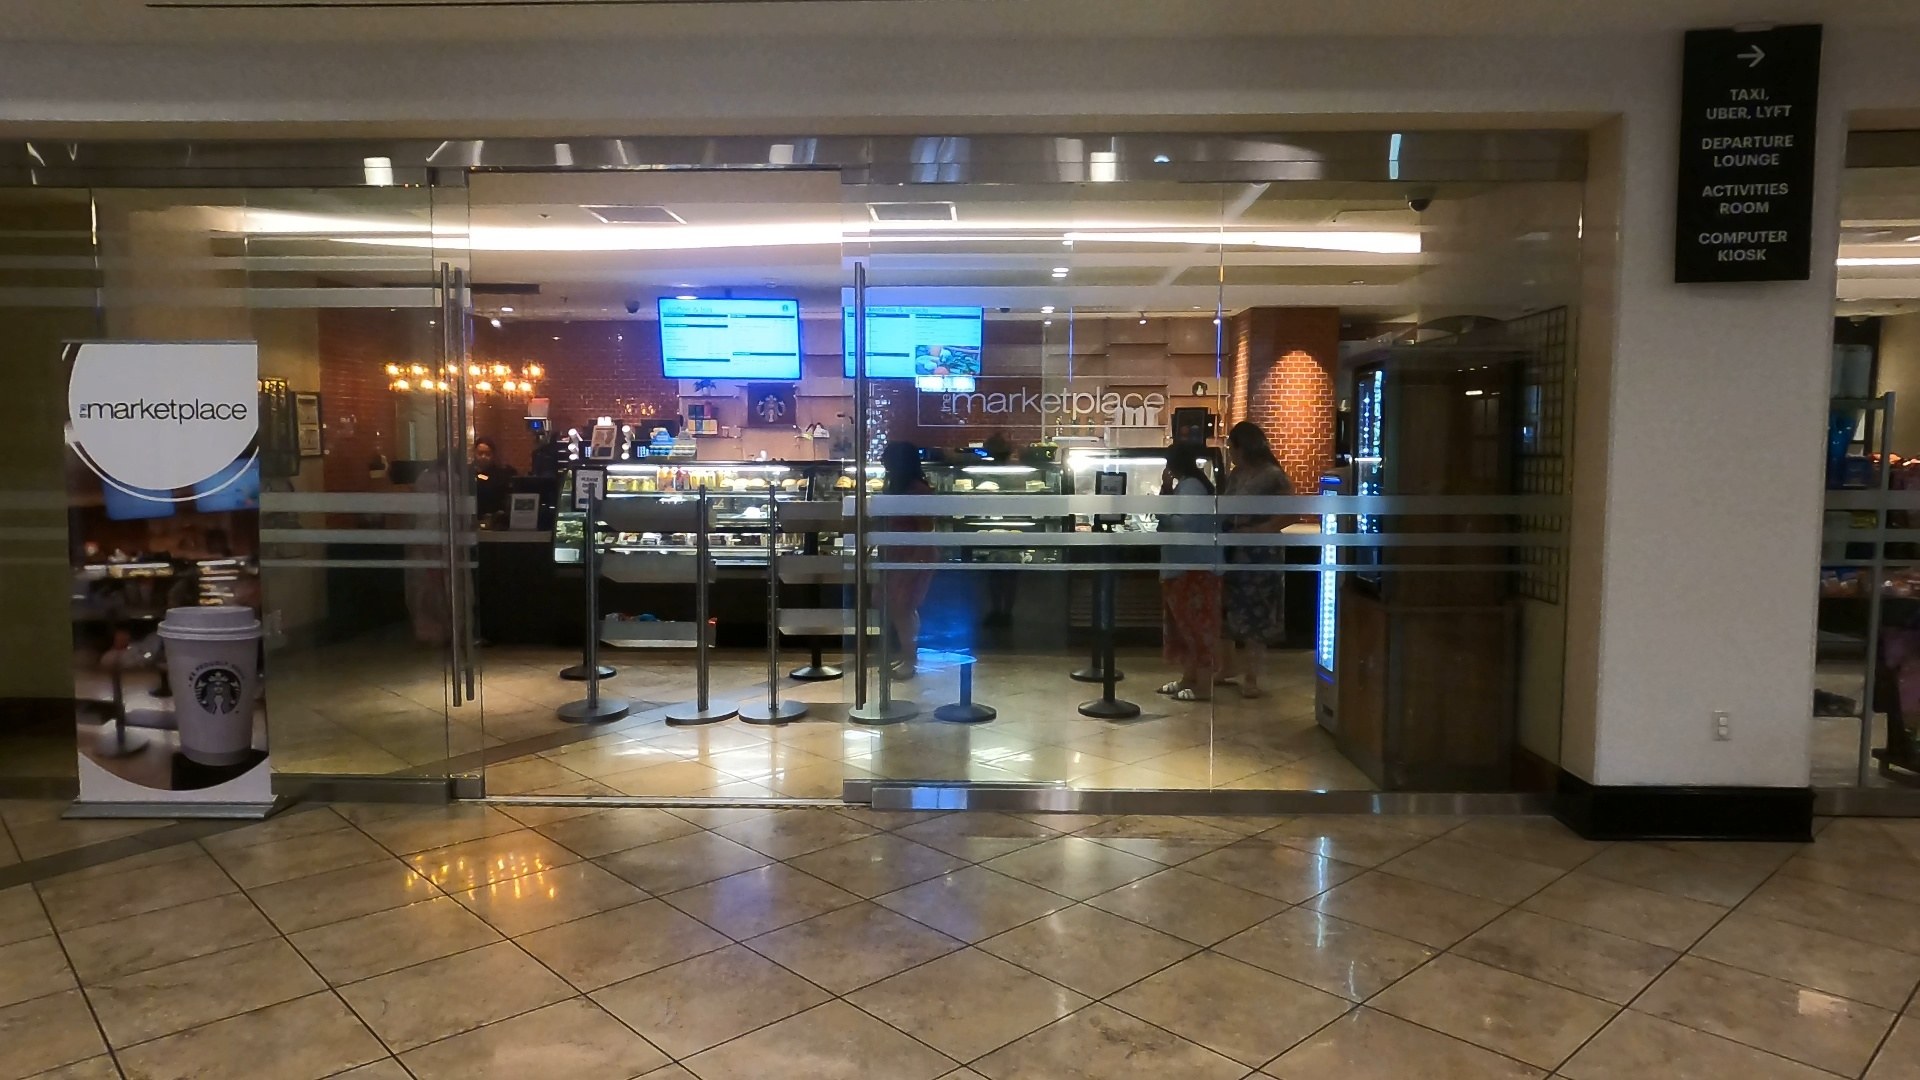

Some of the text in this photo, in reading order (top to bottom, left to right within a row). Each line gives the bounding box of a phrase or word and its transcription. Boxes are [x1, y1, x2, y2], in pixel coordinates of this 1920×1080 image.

[1729, 88, 1769, 101] TAXI,
[1706, 105, 1792, 120] UBER, LYFT
[1701, 135, 1794, 149] DEPARTURE
[1713, 153, 1779, 167] LOUNGE
[1702, 182, 1789, 197] ACTIVITIES
[1719, 201, 1769, 215] ROOM
[1698, 230, 1788, 245] COMPUTER
[1718, 248, 1767, 262] KIOSK
[952, 386, 1165, 420] marketplace
[87, 398, 247, 424] marketplace
